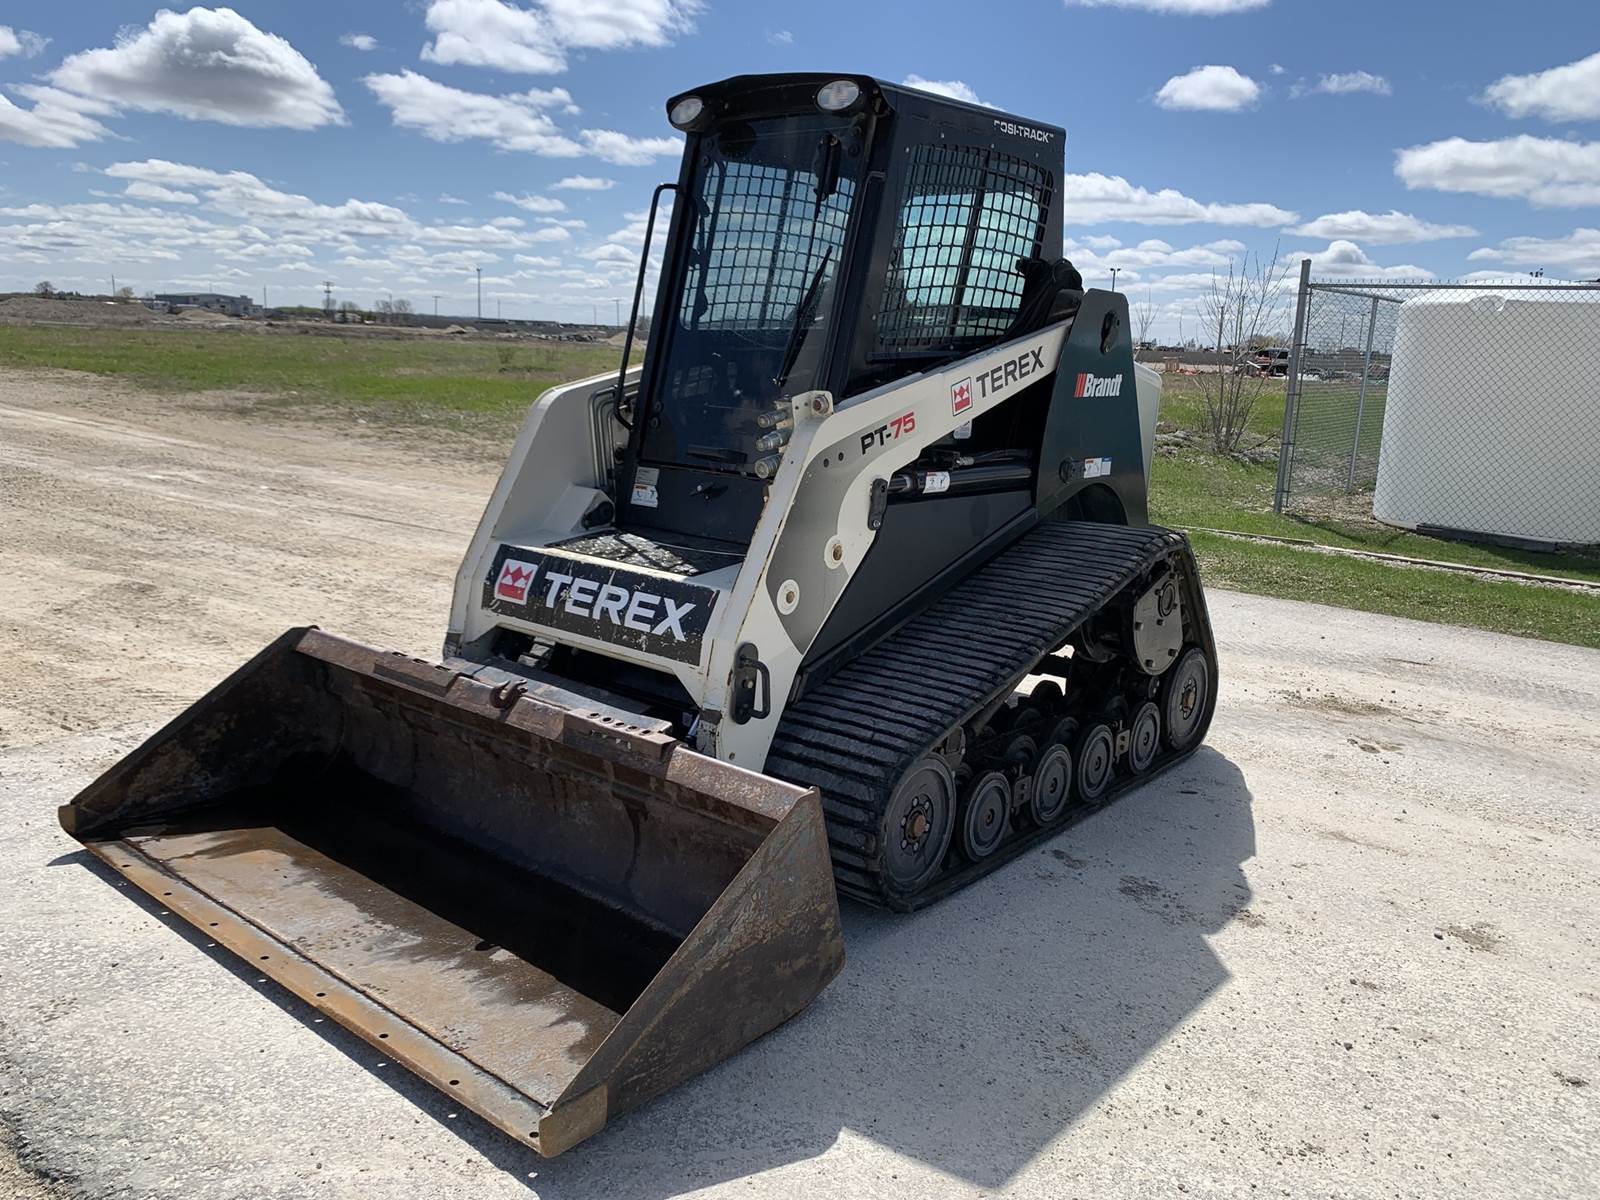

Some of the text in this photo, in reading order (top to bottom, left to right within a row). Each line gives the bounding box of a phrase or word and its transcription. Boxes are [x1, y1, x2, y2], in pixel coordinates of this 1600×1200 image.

[976, 346, 1045, 398] TEREX
[1083, 373, 1122, 397] Brandt
[860, 412, 916, 455] PT-75
[545, 571, 696, 642] TEREX
